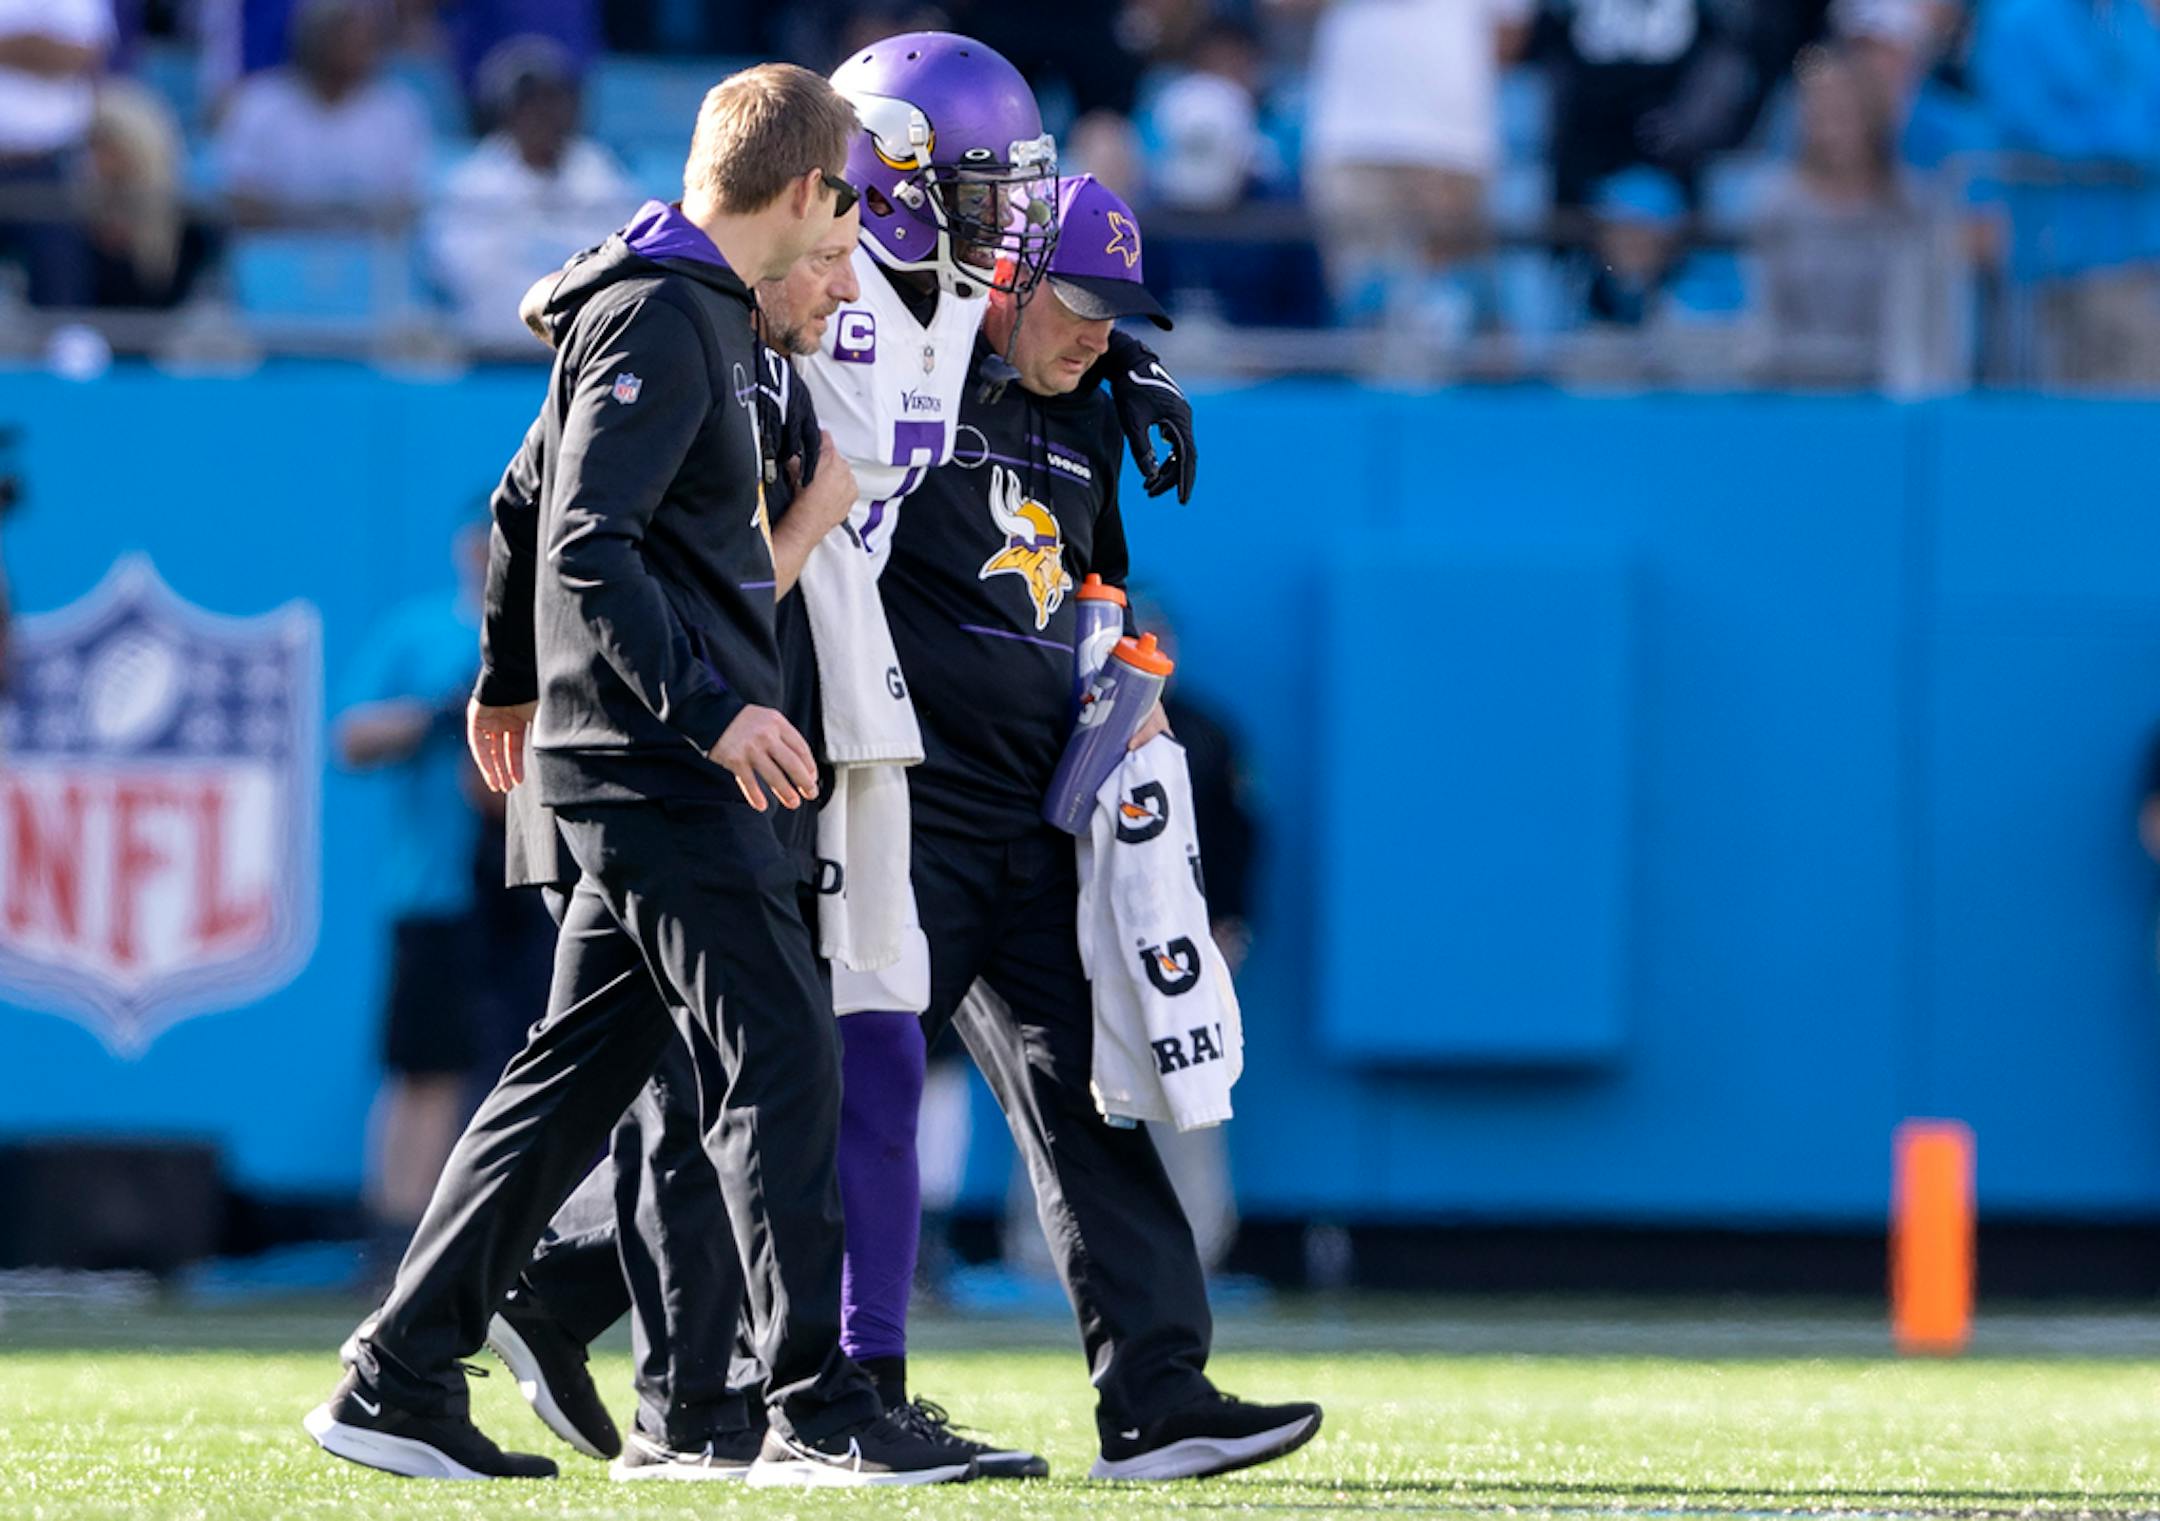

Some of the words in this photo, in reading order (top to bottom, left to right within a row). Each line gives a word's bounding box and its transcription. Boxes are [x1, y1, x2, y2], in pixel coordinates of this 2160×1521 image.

[840, 312, 875, 352] C
[5, 783, 270, 962] NFL
[1151, 1022, 1224, 1076] RA
